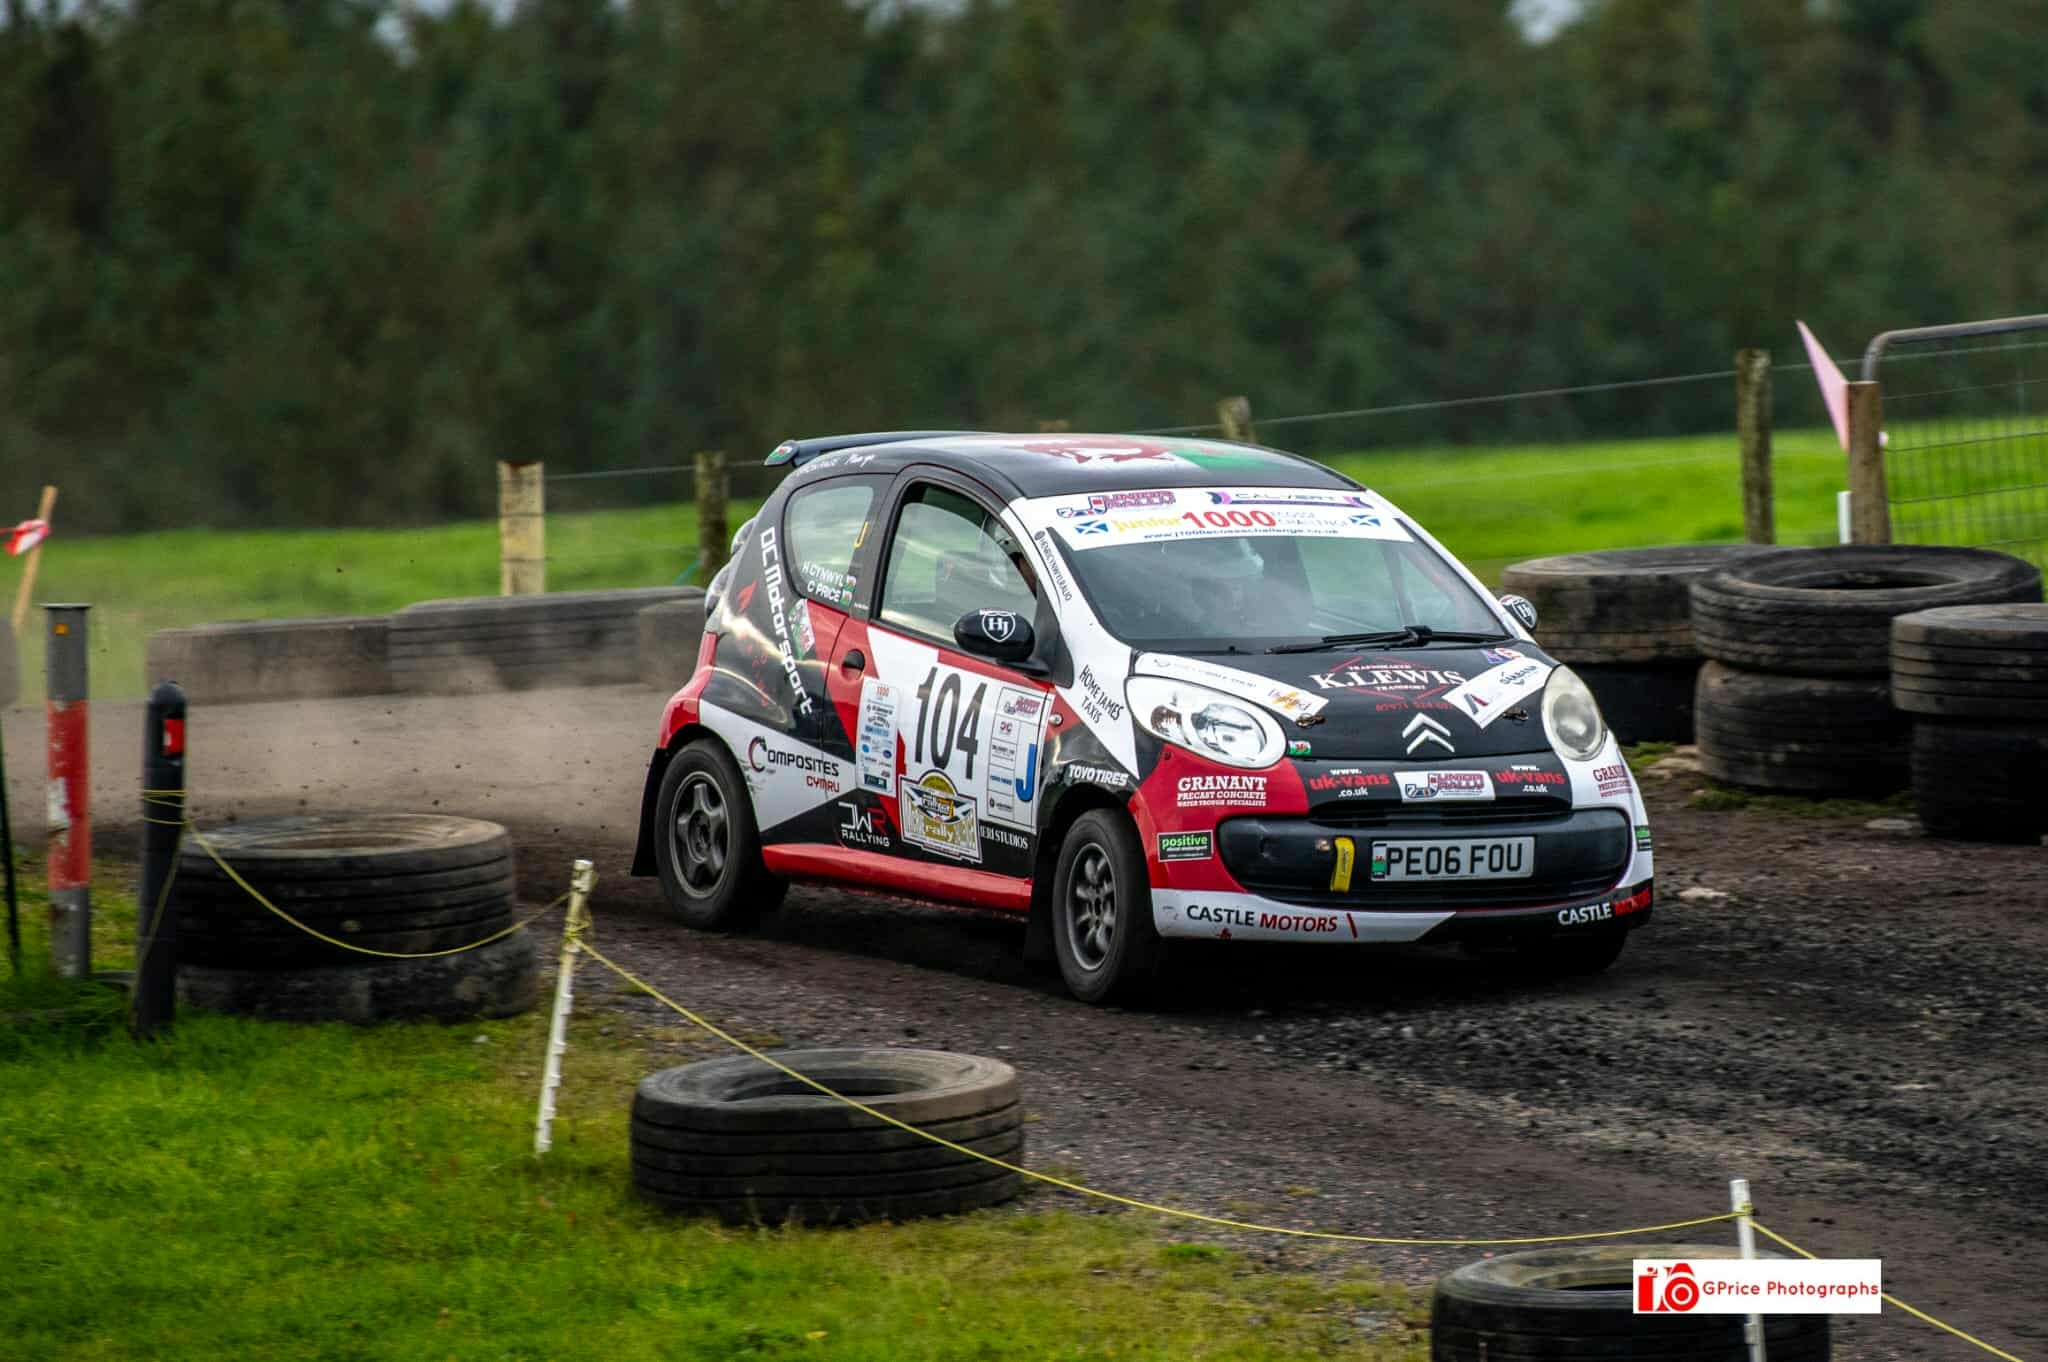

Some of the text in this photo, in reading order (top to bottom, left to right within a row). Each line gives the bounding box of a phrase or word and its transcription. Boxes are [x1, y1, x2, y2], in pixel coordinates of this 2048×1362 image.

[1182, 510, 1277, 529] 1000
[807, 580, 841, 602] C PRICE
[1079, 663, 1124, 721] HOME JAMES
[915, 666, 987, 780] 104
[1015, 744, 1038, 803] J
[1069, 764, 1129, 787] TOYO TIRES
[1177, 775, 1267, 791] GRANANT
[1309, 773, 1390, 791] uk-vans
[1495, 769, 1566, 784] uk-vans
[806, 775, 840, 793] CYMRU
[1338, 786, 1368, 798] .co.uk
[1177, 791, 1266, 801] PRECAST CONCRETE
[841, 829, 890, 847] RALLYING
[995, 829, 1028, 850] STUDIOS
[1162, 834, 1208, 850] positive
[1386, 843, 1522, 875] PE06 FOU
[1186, 904, 1338, 933] CASTLE MOTORS
[1558, 902, 1612, 926] CASTLE
